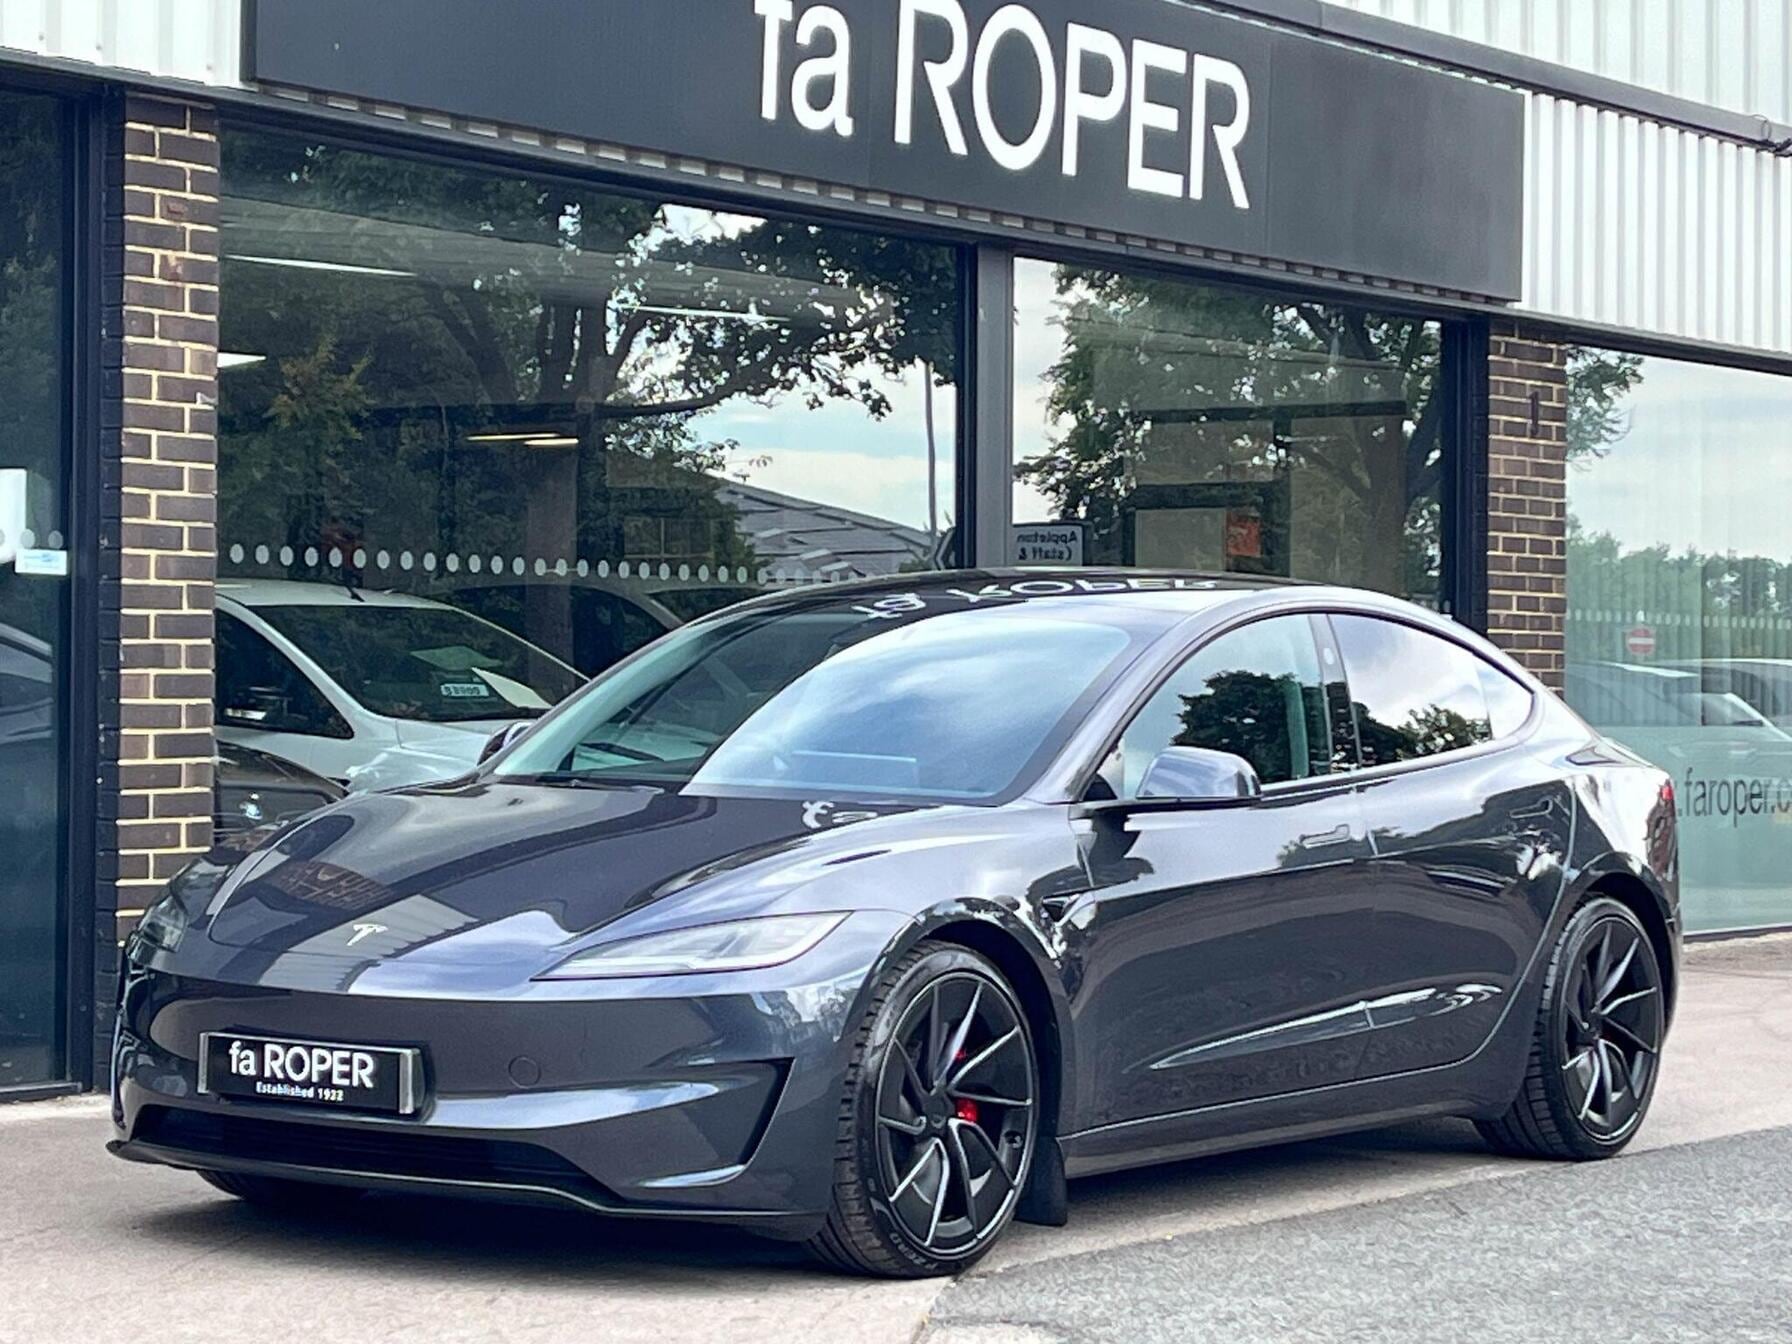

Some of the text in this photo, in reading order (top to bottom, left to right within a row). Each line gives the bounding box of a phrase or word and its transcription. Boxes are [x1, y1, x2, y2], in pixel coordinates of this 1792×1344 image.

[894, 0, 1250, 209] ROPER
[230, 1040, 373, 1088] fa ROPER
[256, 1081, 314, 1098] Established
